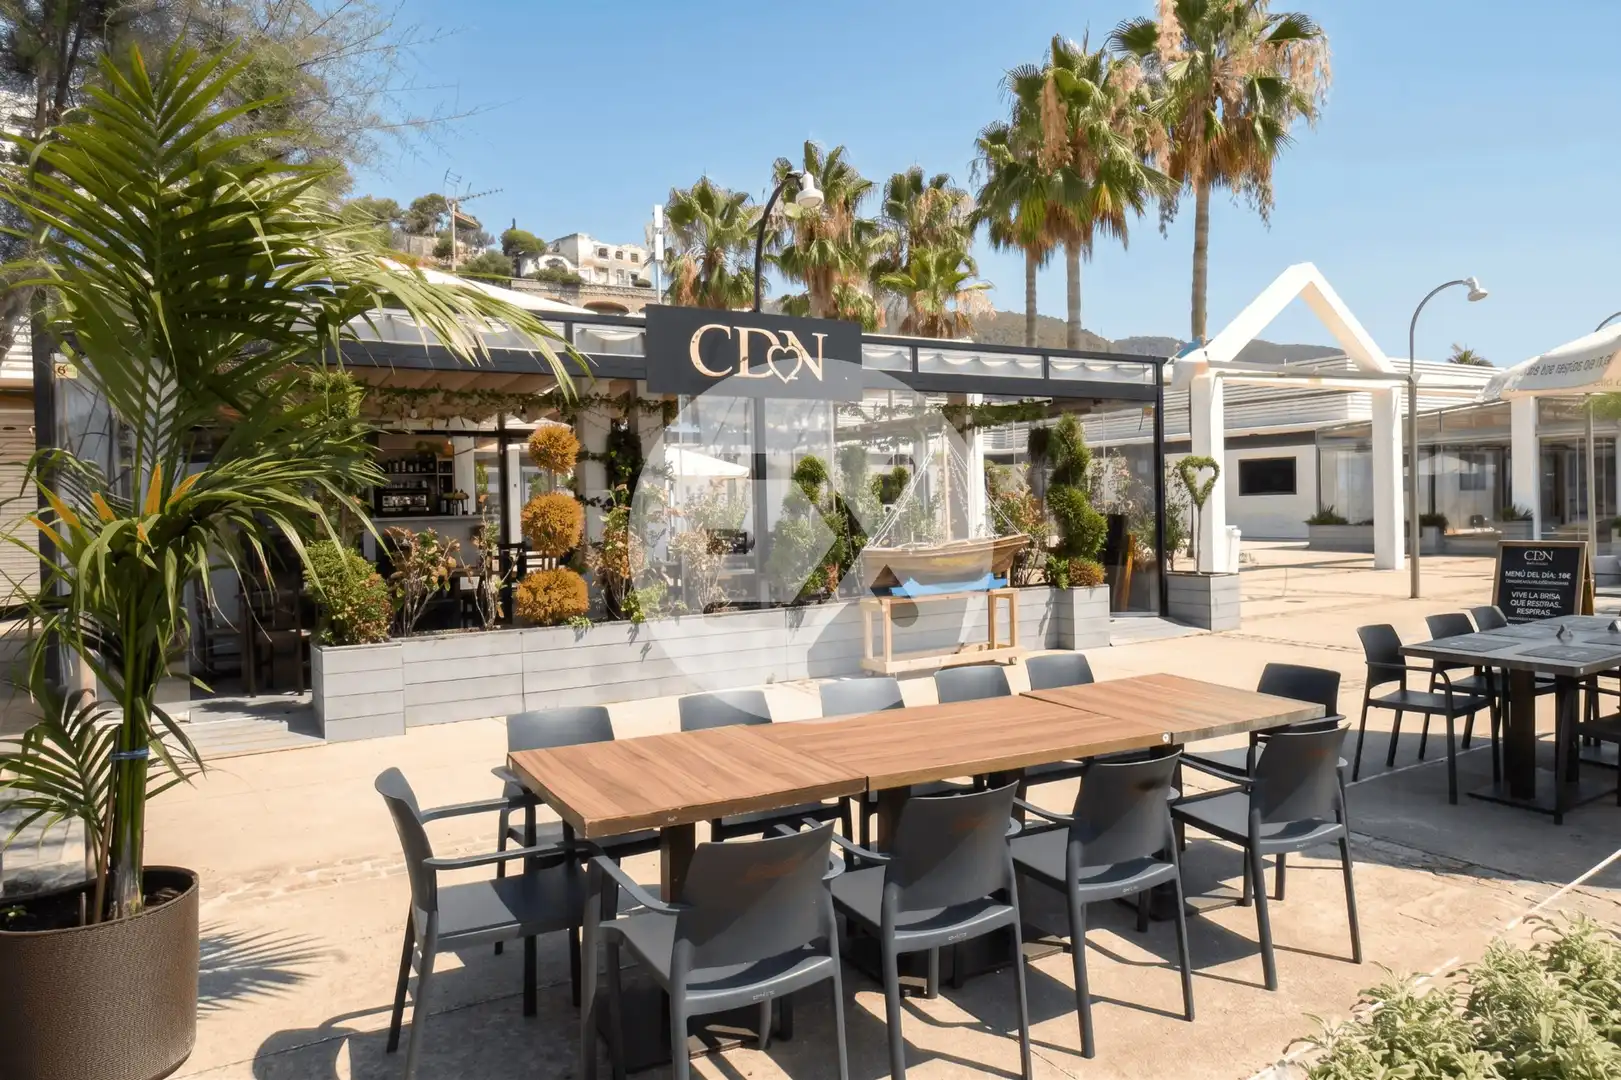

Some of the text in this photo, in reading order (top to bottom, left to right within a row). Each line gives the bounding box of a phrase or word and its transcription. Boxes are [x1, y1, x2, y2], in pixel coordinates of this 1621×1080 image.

[1505, 569, 1526, 578] MENÚ
[1526, 571, 1540, 579] DEL
[1511, 591, 1528, 599] VIVE
[1528, 592, 1538, 600] LA
